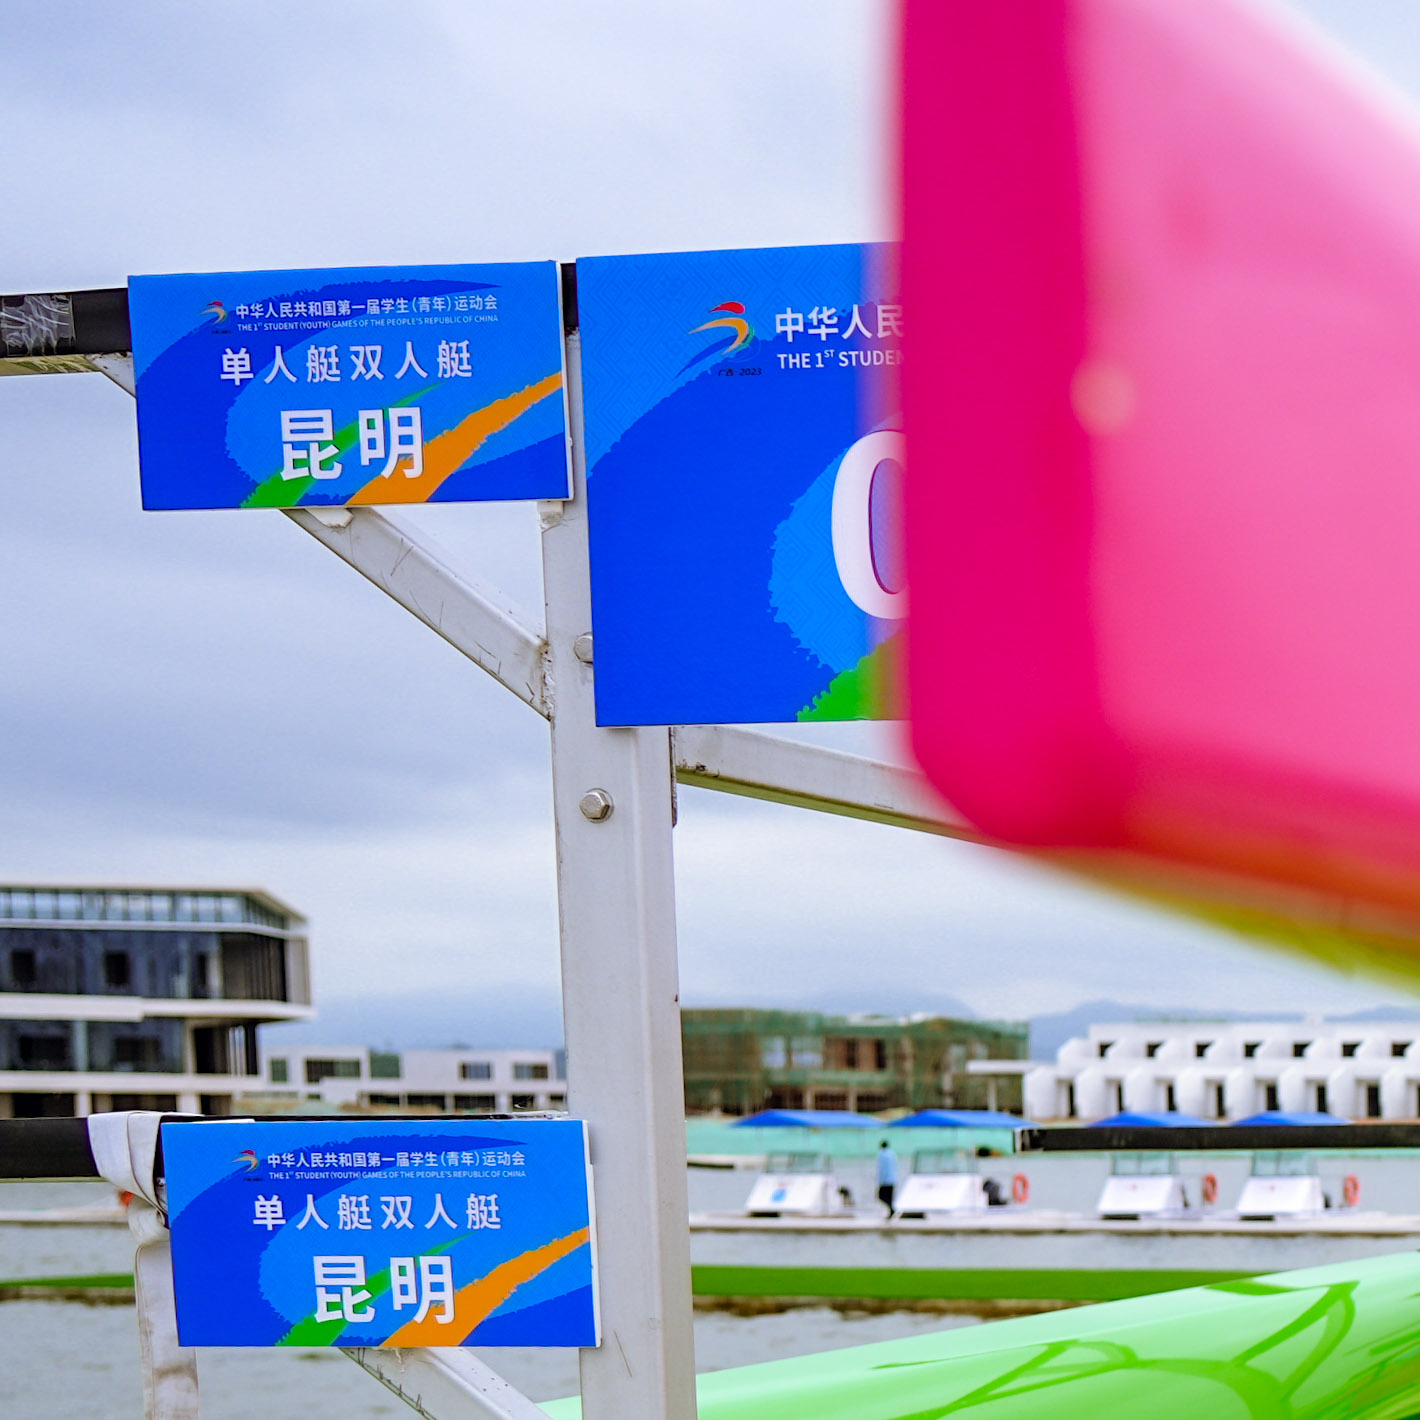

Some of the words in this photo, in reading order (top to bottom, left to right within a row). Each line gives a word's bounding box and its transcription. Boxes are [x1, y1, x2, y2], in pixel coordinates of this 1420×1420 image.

[237, 323, 252, 332] THE
[264, 322, 299, 331] STUDENT
[300, 320, 332, 330] (YOUTH)
[332, 320, 358, 328] GAMES
[359, 320, 369, 328] OF
[371, 319, 386, 327] THE
[387, 318, 423, 326] PEOPLE'S
[424, 316, 462, 325] REPUBLIC
[462, 316, 474, 324] OF
[474, 314, 498, 323] CHINA
[775, 303, 904, 343] 中华人民
[220, 340, 472, 386] 单人艇双人艇
[777, 352, 811, 369] THE
[280, 406, 424, 481] 昆明
[269, 1172, 284, 1180] THE
[295, 1171, 329, 1180] STUDENT
[330, 1170, 360, 1180] (YOUTH)
[362, 1171, 388, 1179] GAMES
[400, 1170, 415, 1178] THE
[416, 1170, 452, 1178] PEOPLE'S
[453, 1170, 490, 1178] REPUBLIC
[490, 1170, 501, 1178] OF
[502, 1170, 526, 1178] CHINA
[253, 1192, 501, 1231] 单人艇双人艇
[313, 1255, 456, 1325] 昆明
